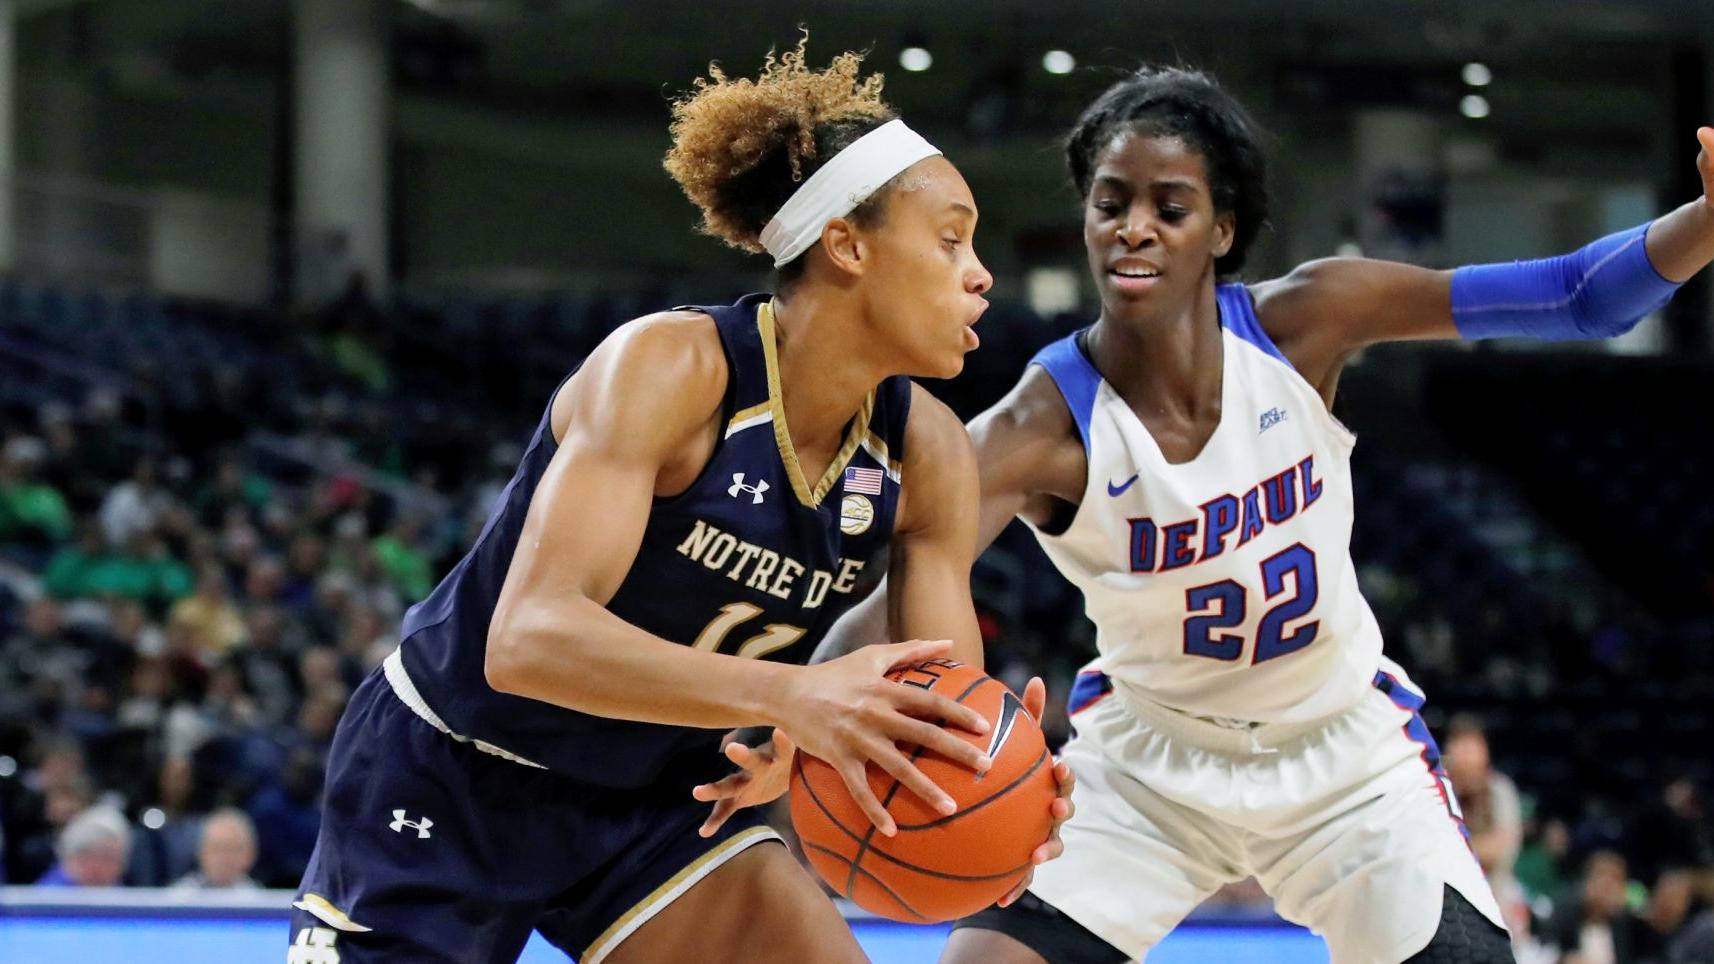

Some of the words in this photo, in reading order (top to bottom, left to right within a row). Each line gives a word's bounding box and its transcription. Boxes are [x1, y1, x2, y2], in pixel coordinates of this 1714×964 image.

[676, 519, 805, 600] NOTRE
[1126, 454, 1323, 574] DEPAUL
[1183, 541, 1320, 666] 22
